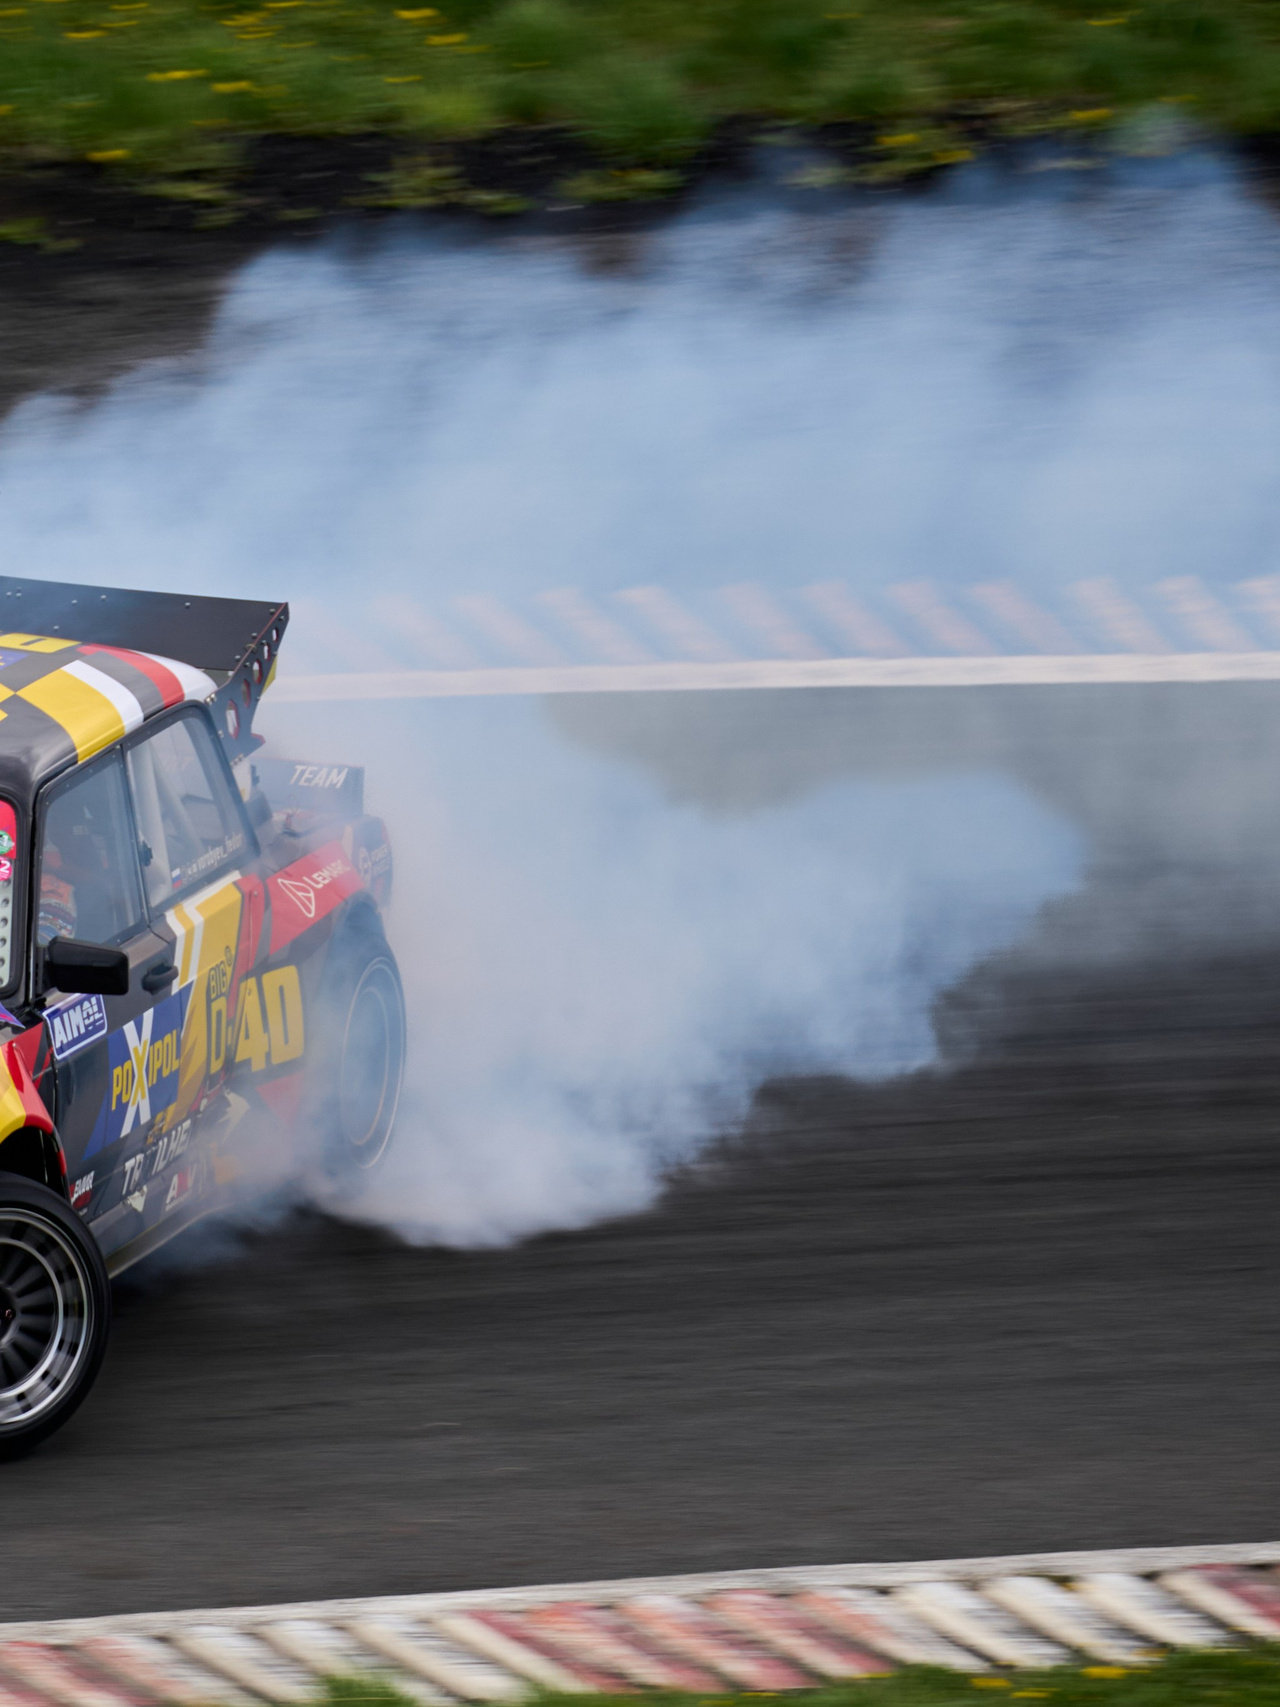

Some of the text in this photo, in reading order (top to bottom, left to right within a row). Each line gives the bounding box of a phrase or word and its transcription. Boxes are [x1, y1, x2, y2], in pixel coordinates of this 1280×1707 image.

[289, 765, 348, 789] TEAM
[0, 860, 10, 873] 2
[208, 960, 227, 998] BIG
[53, 996, 103, 1049] AIMOL
[112, 1007, 180, 1138] POXIPOL
